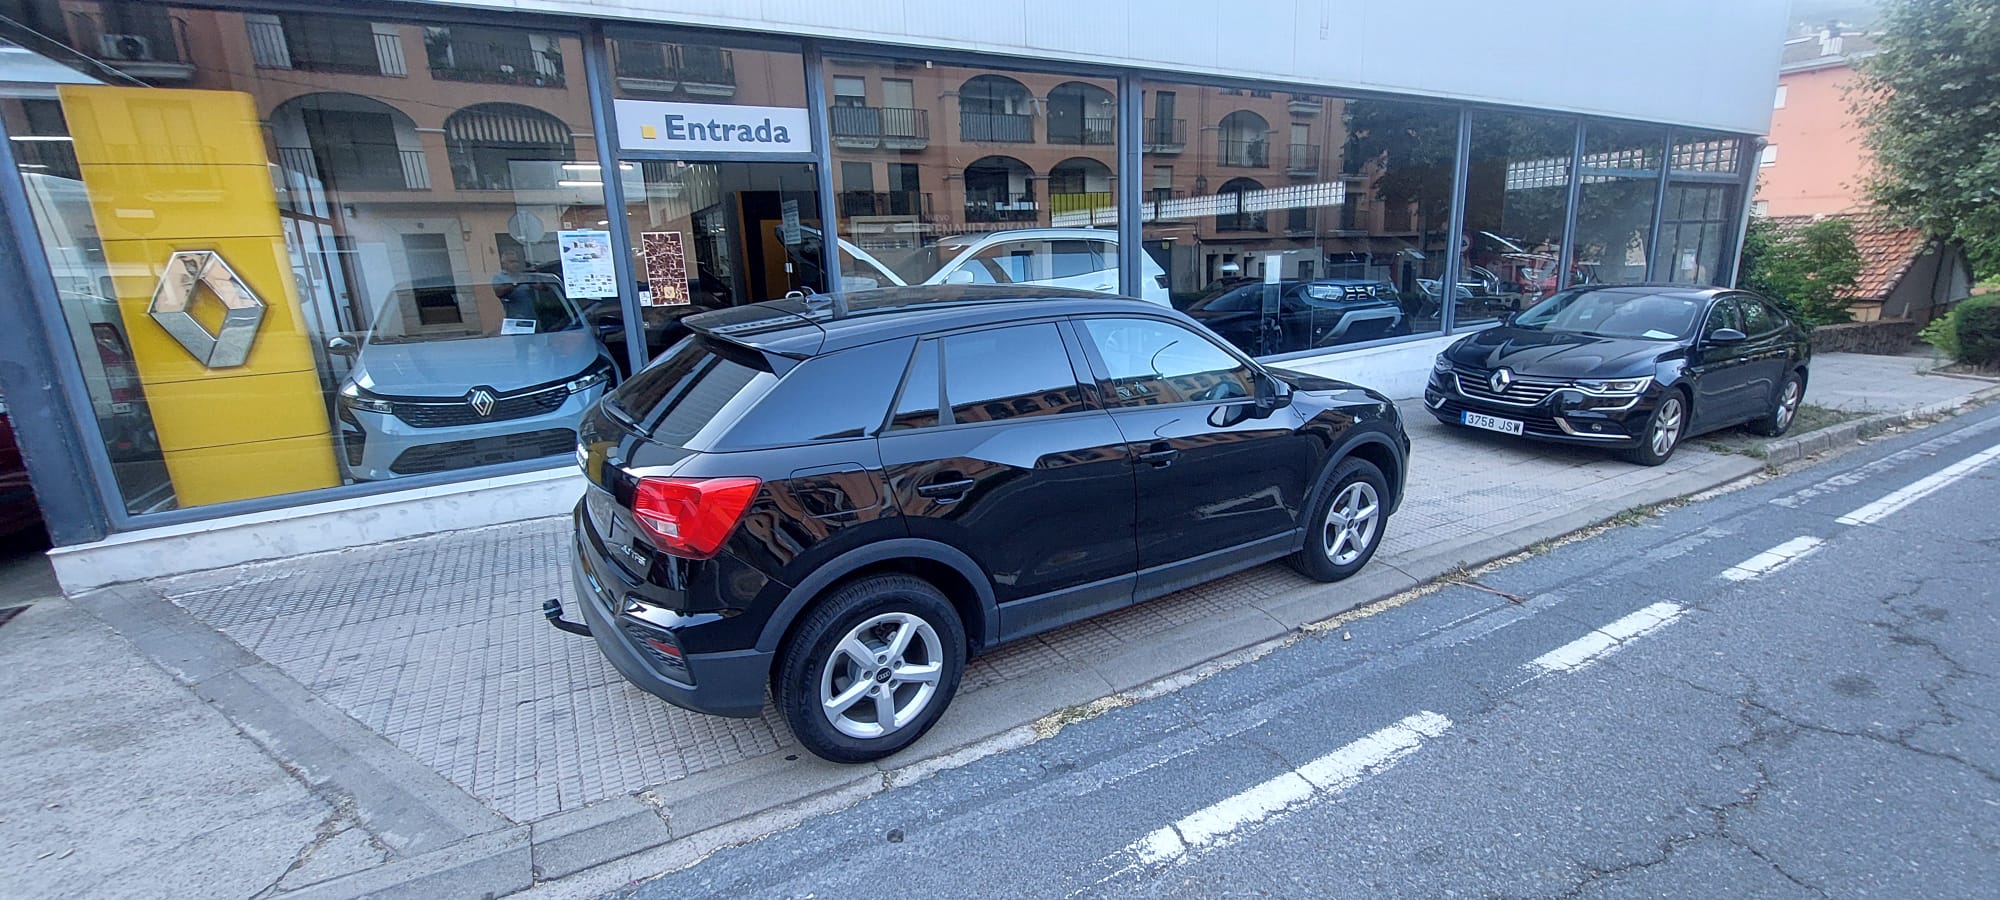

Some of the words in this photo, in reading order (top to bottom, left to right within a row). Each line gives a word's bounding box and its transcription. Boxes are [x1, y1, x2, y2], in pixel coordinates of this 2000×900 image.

[664, 114, 791, 143] Entrada
[1468, 414, 1495, 428] 3758
[1498, 420, 1521, 433] JSW
